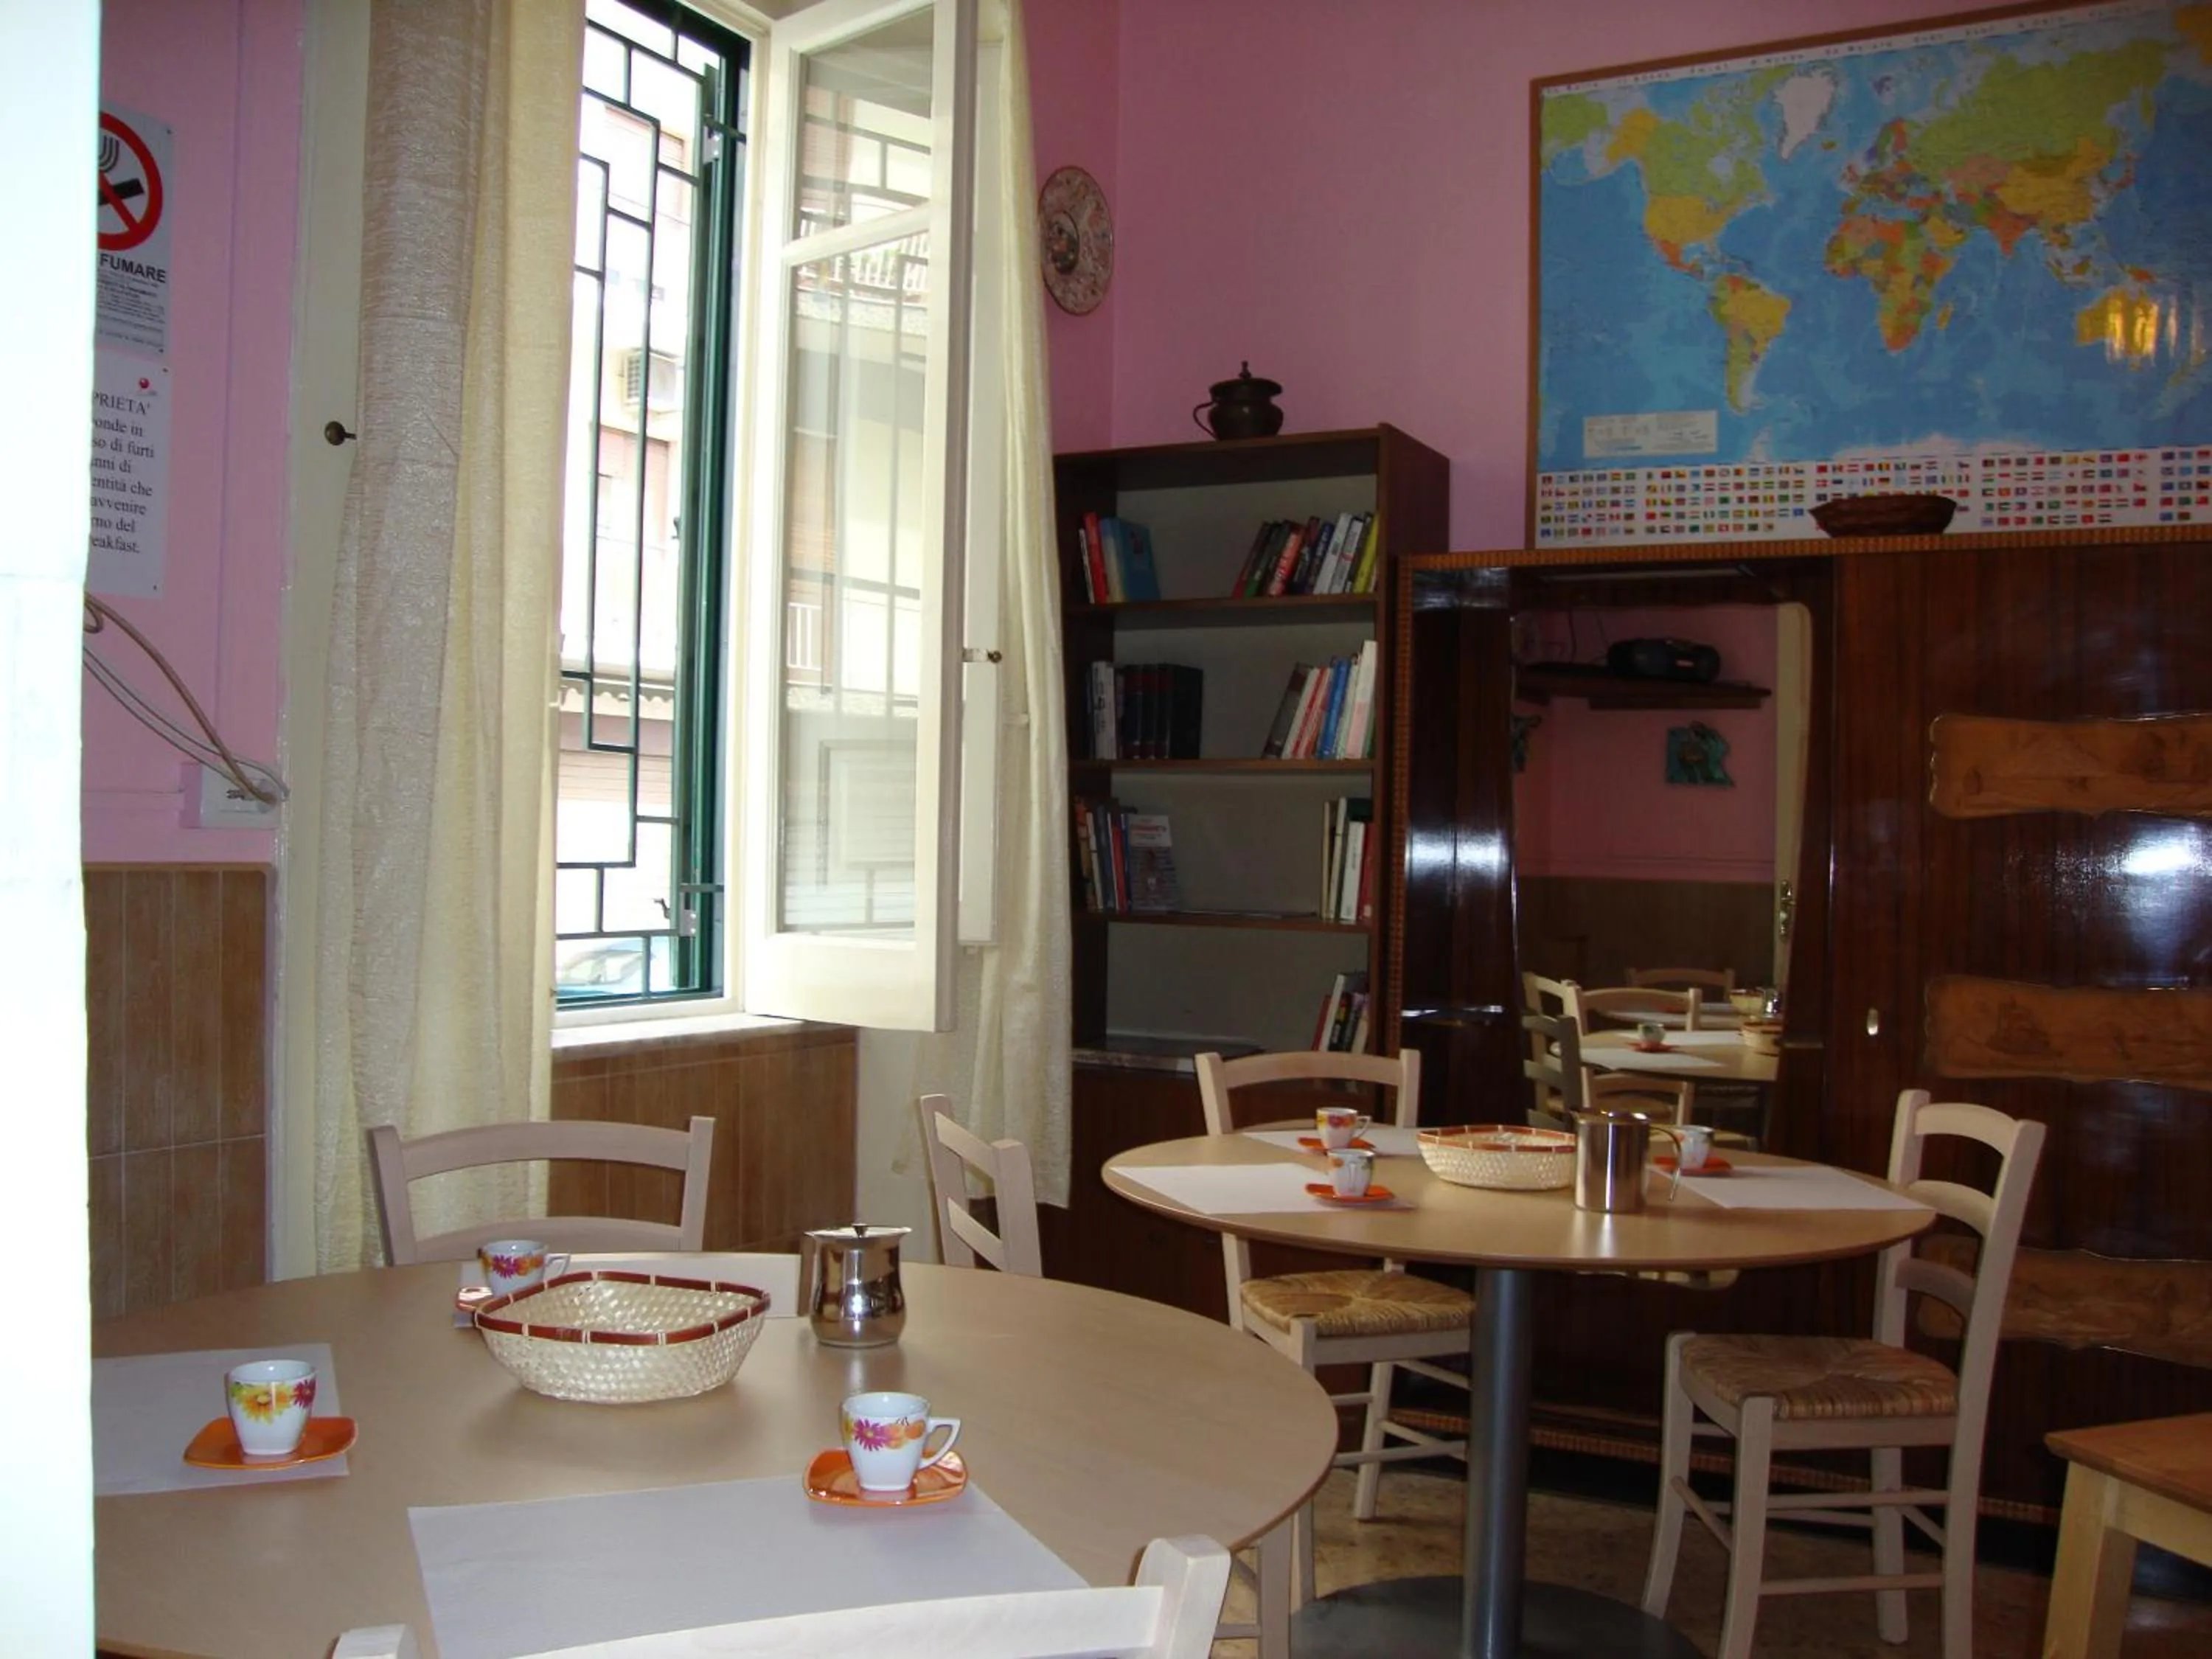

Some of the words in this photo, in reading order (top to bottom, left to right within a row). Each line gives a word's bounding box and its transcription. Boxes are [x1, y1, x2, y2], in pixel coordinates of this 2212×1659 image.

[100, 254, 166, 283] FUMARE
[94, 418, 127, 433] onde
[131, 421, 143, 437] in
[110, 437, 122, 453] di
[128, 440, 154, 458] furti
[119, 459, 131, 473] di
[130, 480, 153, 496] che
[91, 496, 147, 515] avvenire
[116, 516, 135, 533] del
